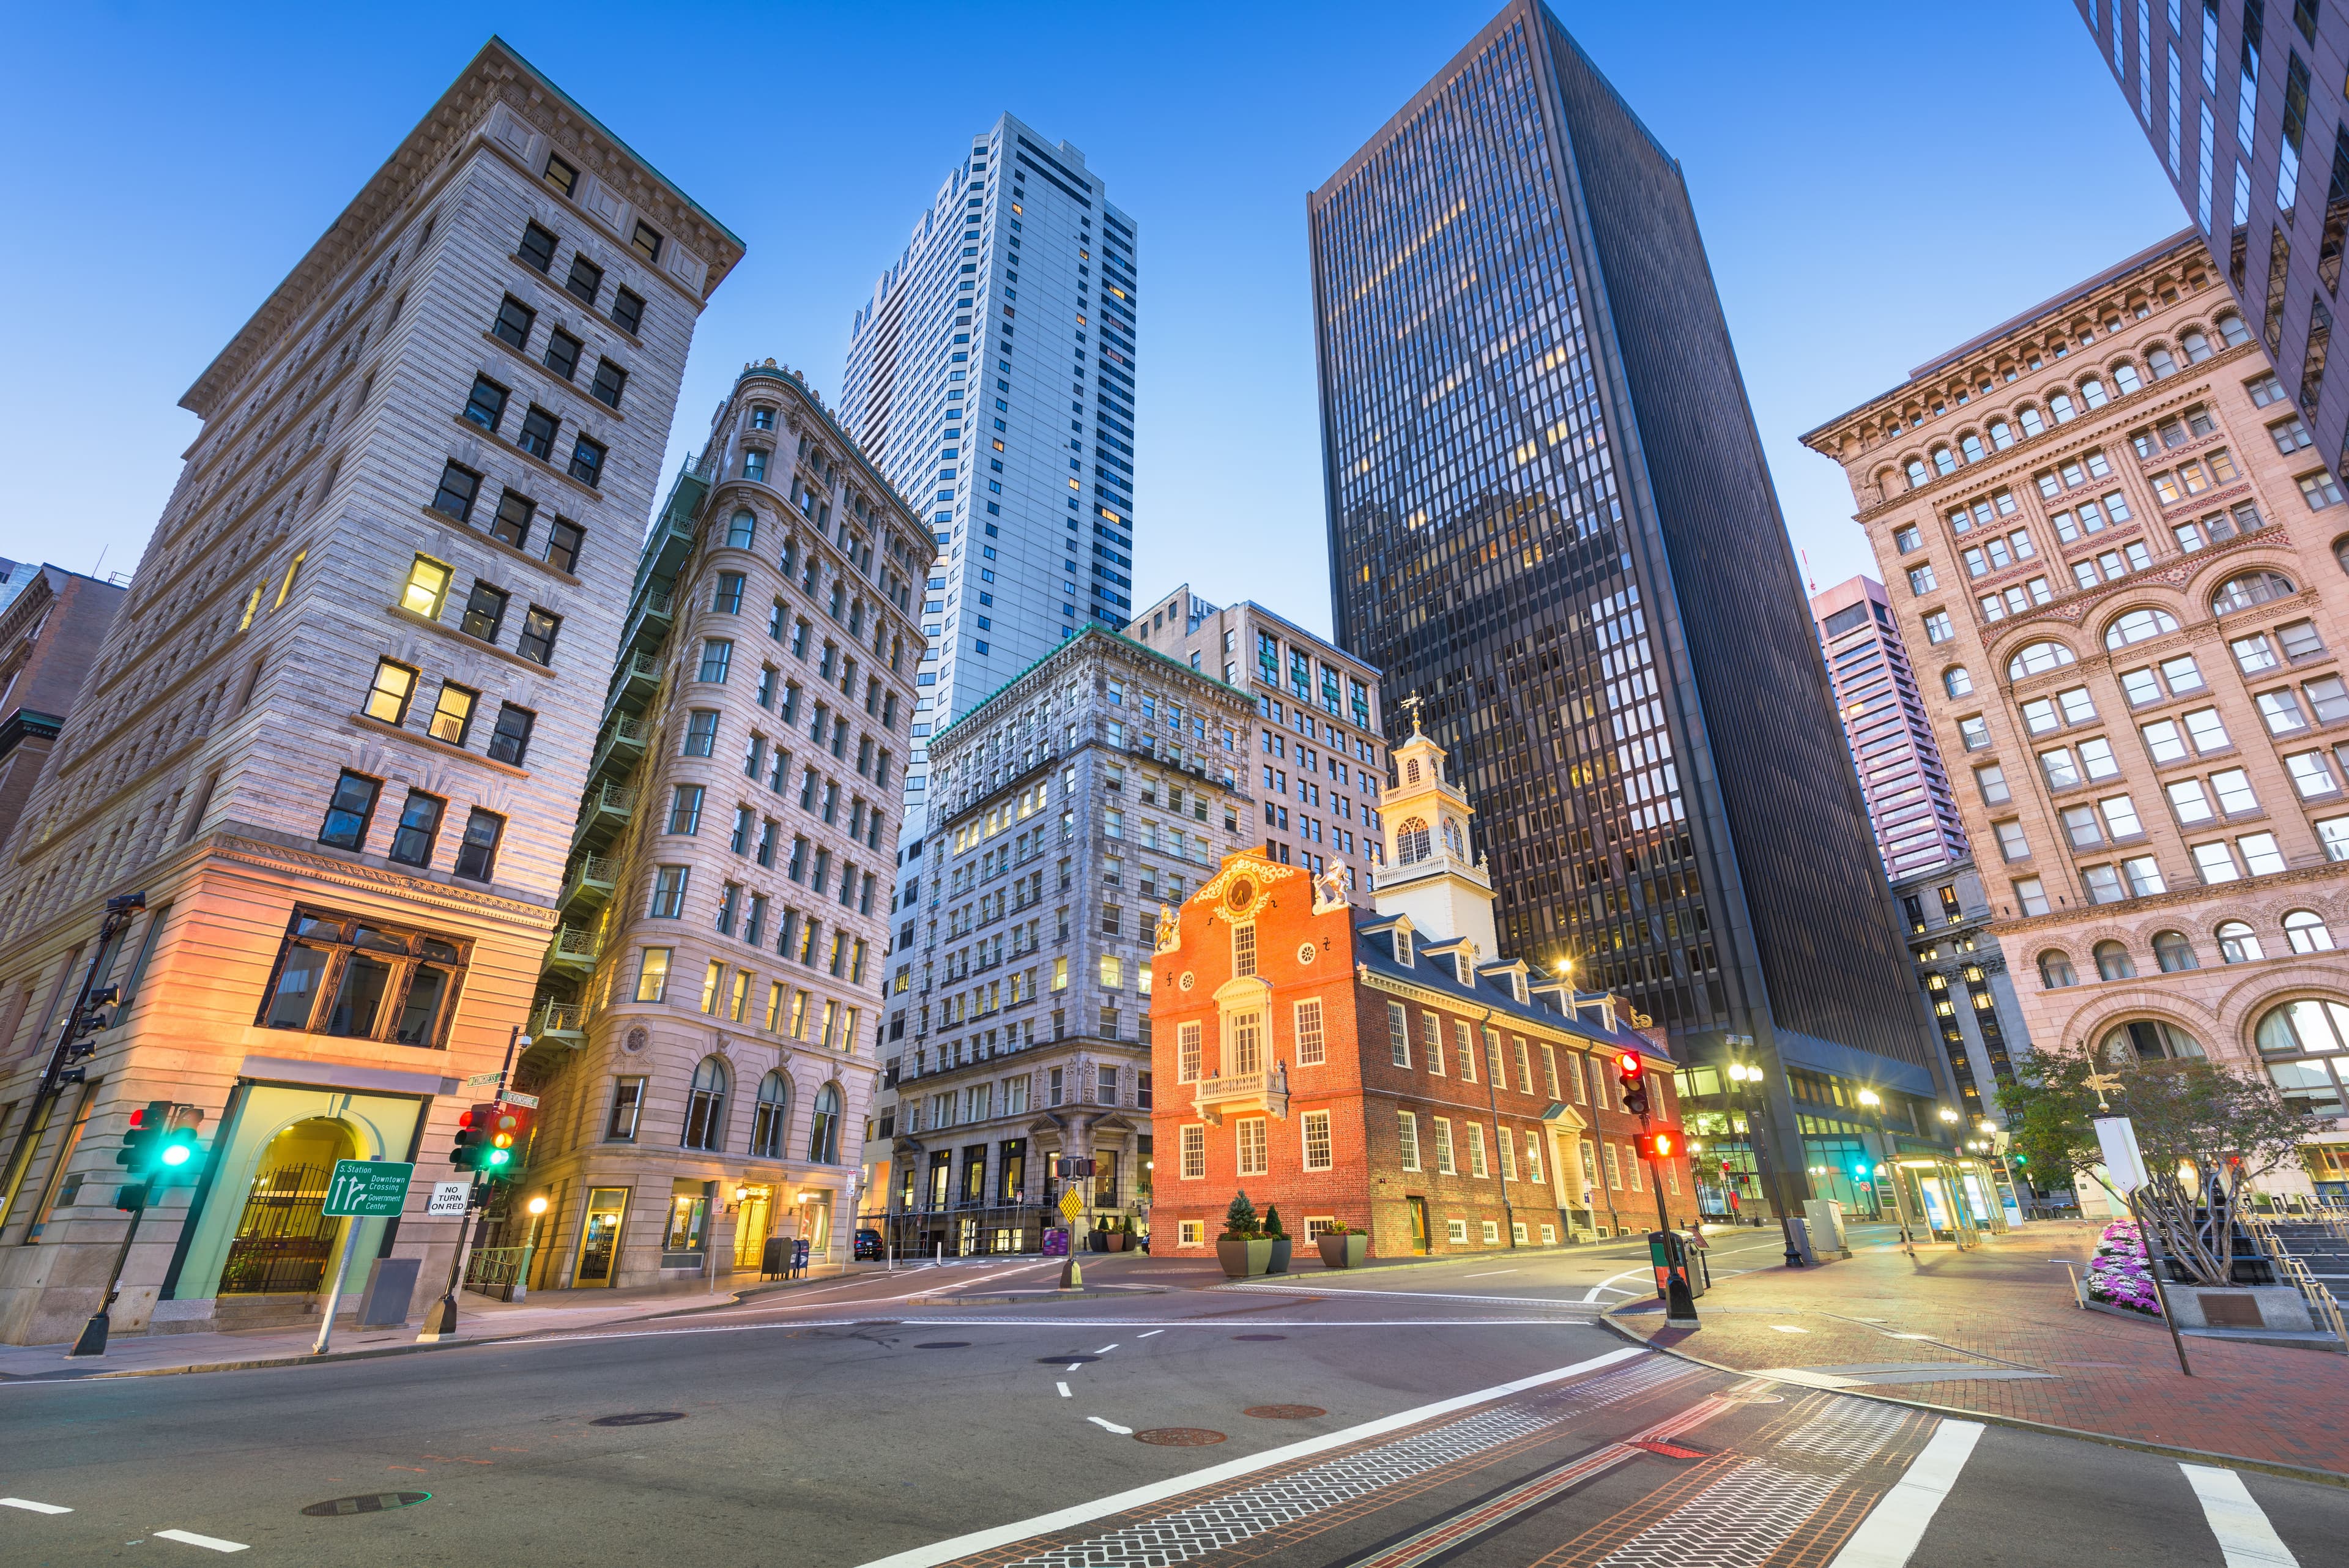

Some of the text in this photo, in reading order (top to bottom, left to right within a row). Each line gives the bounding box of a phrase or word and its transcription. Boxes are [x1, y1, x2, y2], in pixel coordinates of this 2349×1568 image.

[473, 1074, 497, 1085] CONGRESS
[507, 1093, 533, 1106] DEVONSHIRE
[371, 1175, 406, 1183] Downtown
[369, 1183, 399, 1192] Crossing
[368, 1194, 401, 1202] Government
